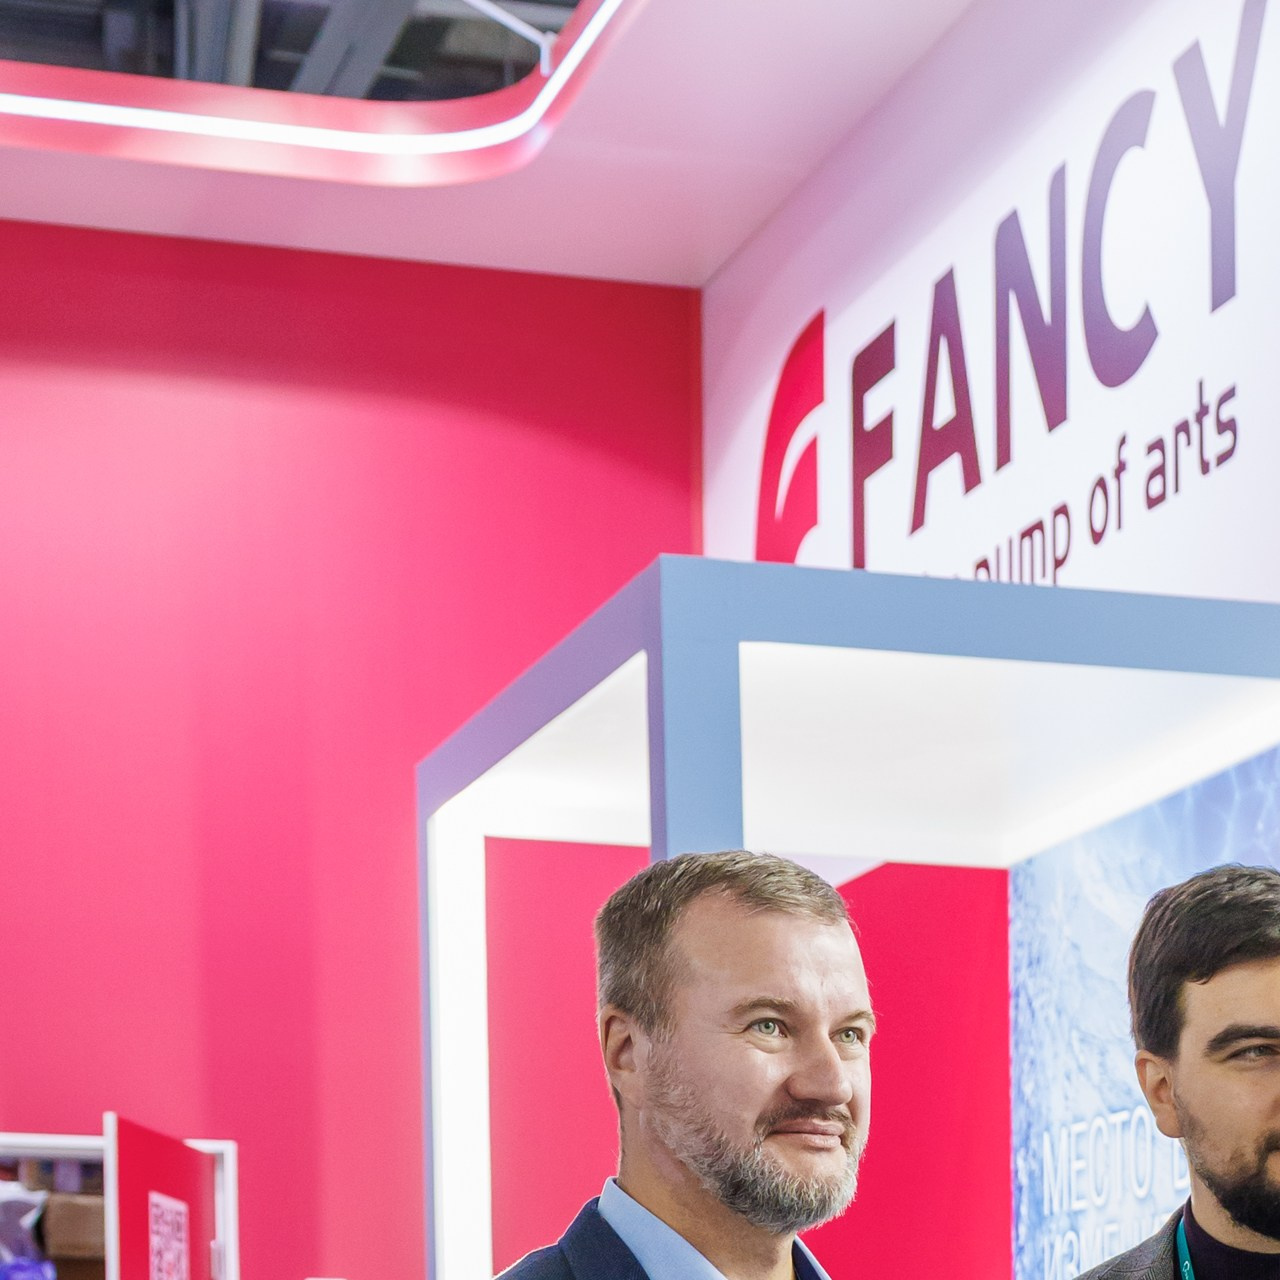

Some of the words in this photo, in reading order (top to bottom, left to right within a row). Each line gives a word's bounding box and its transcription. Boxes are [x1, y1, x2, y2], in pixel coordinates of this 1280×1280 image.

[851, 0, 1268, 571] FANCY
[1089, 433, 1128, 545] of
[1145, 377, 1238, 510] arts
[1043, 1105, 1152, 1217] МЕСТО
